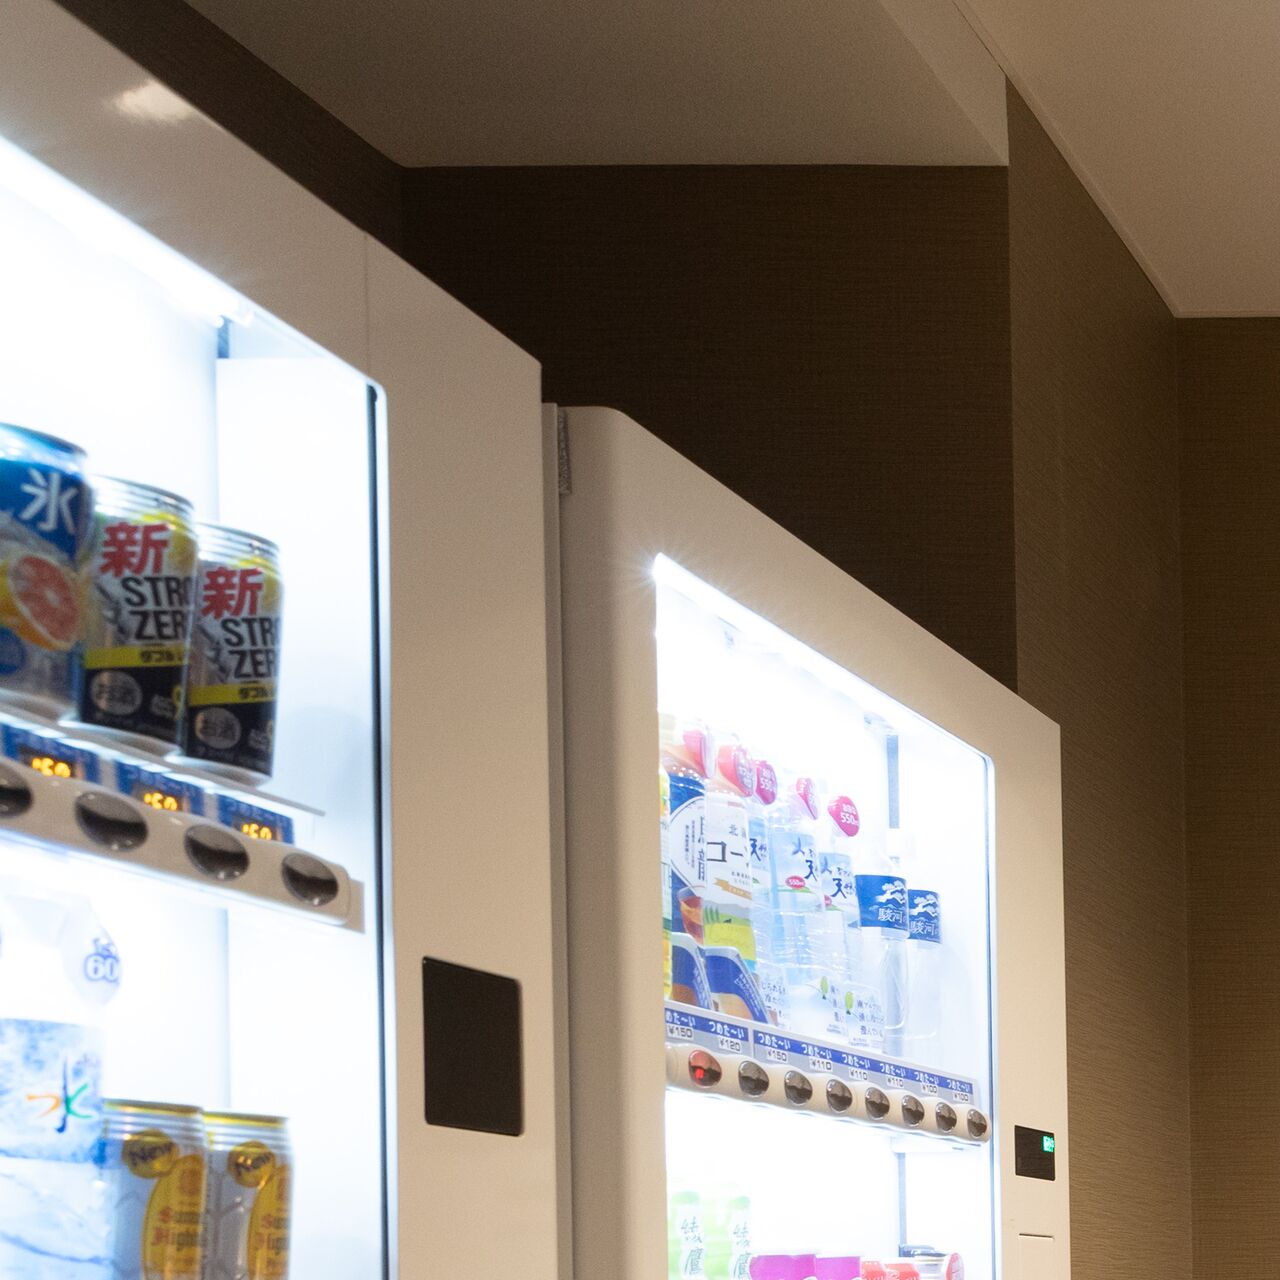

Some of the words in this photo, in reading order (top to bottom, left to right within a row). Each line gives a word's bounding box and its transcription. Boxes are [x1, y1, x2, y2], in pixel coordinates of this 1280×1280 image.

[20, 470, 79, 535] 氷
[100, 522, 169, 577] 新
[202, 567, 263, 620] 新
[877, 907, 904, 923] 駿河
[910, 919, 935, 936] 駿河
[669, 1026, 694, 1040] ¥150
[708, 1020, 745, 1039] つめた〜い
[719, 1038, 741, 1051] ¥120
[758, 1032, 791, 1050] つめた〜い
[801, 1044, 832, 1060] つめた〜い
[811, 1058, 833, 1071] ¥110
[842, 1053, 871, 1070] つめた〜い
